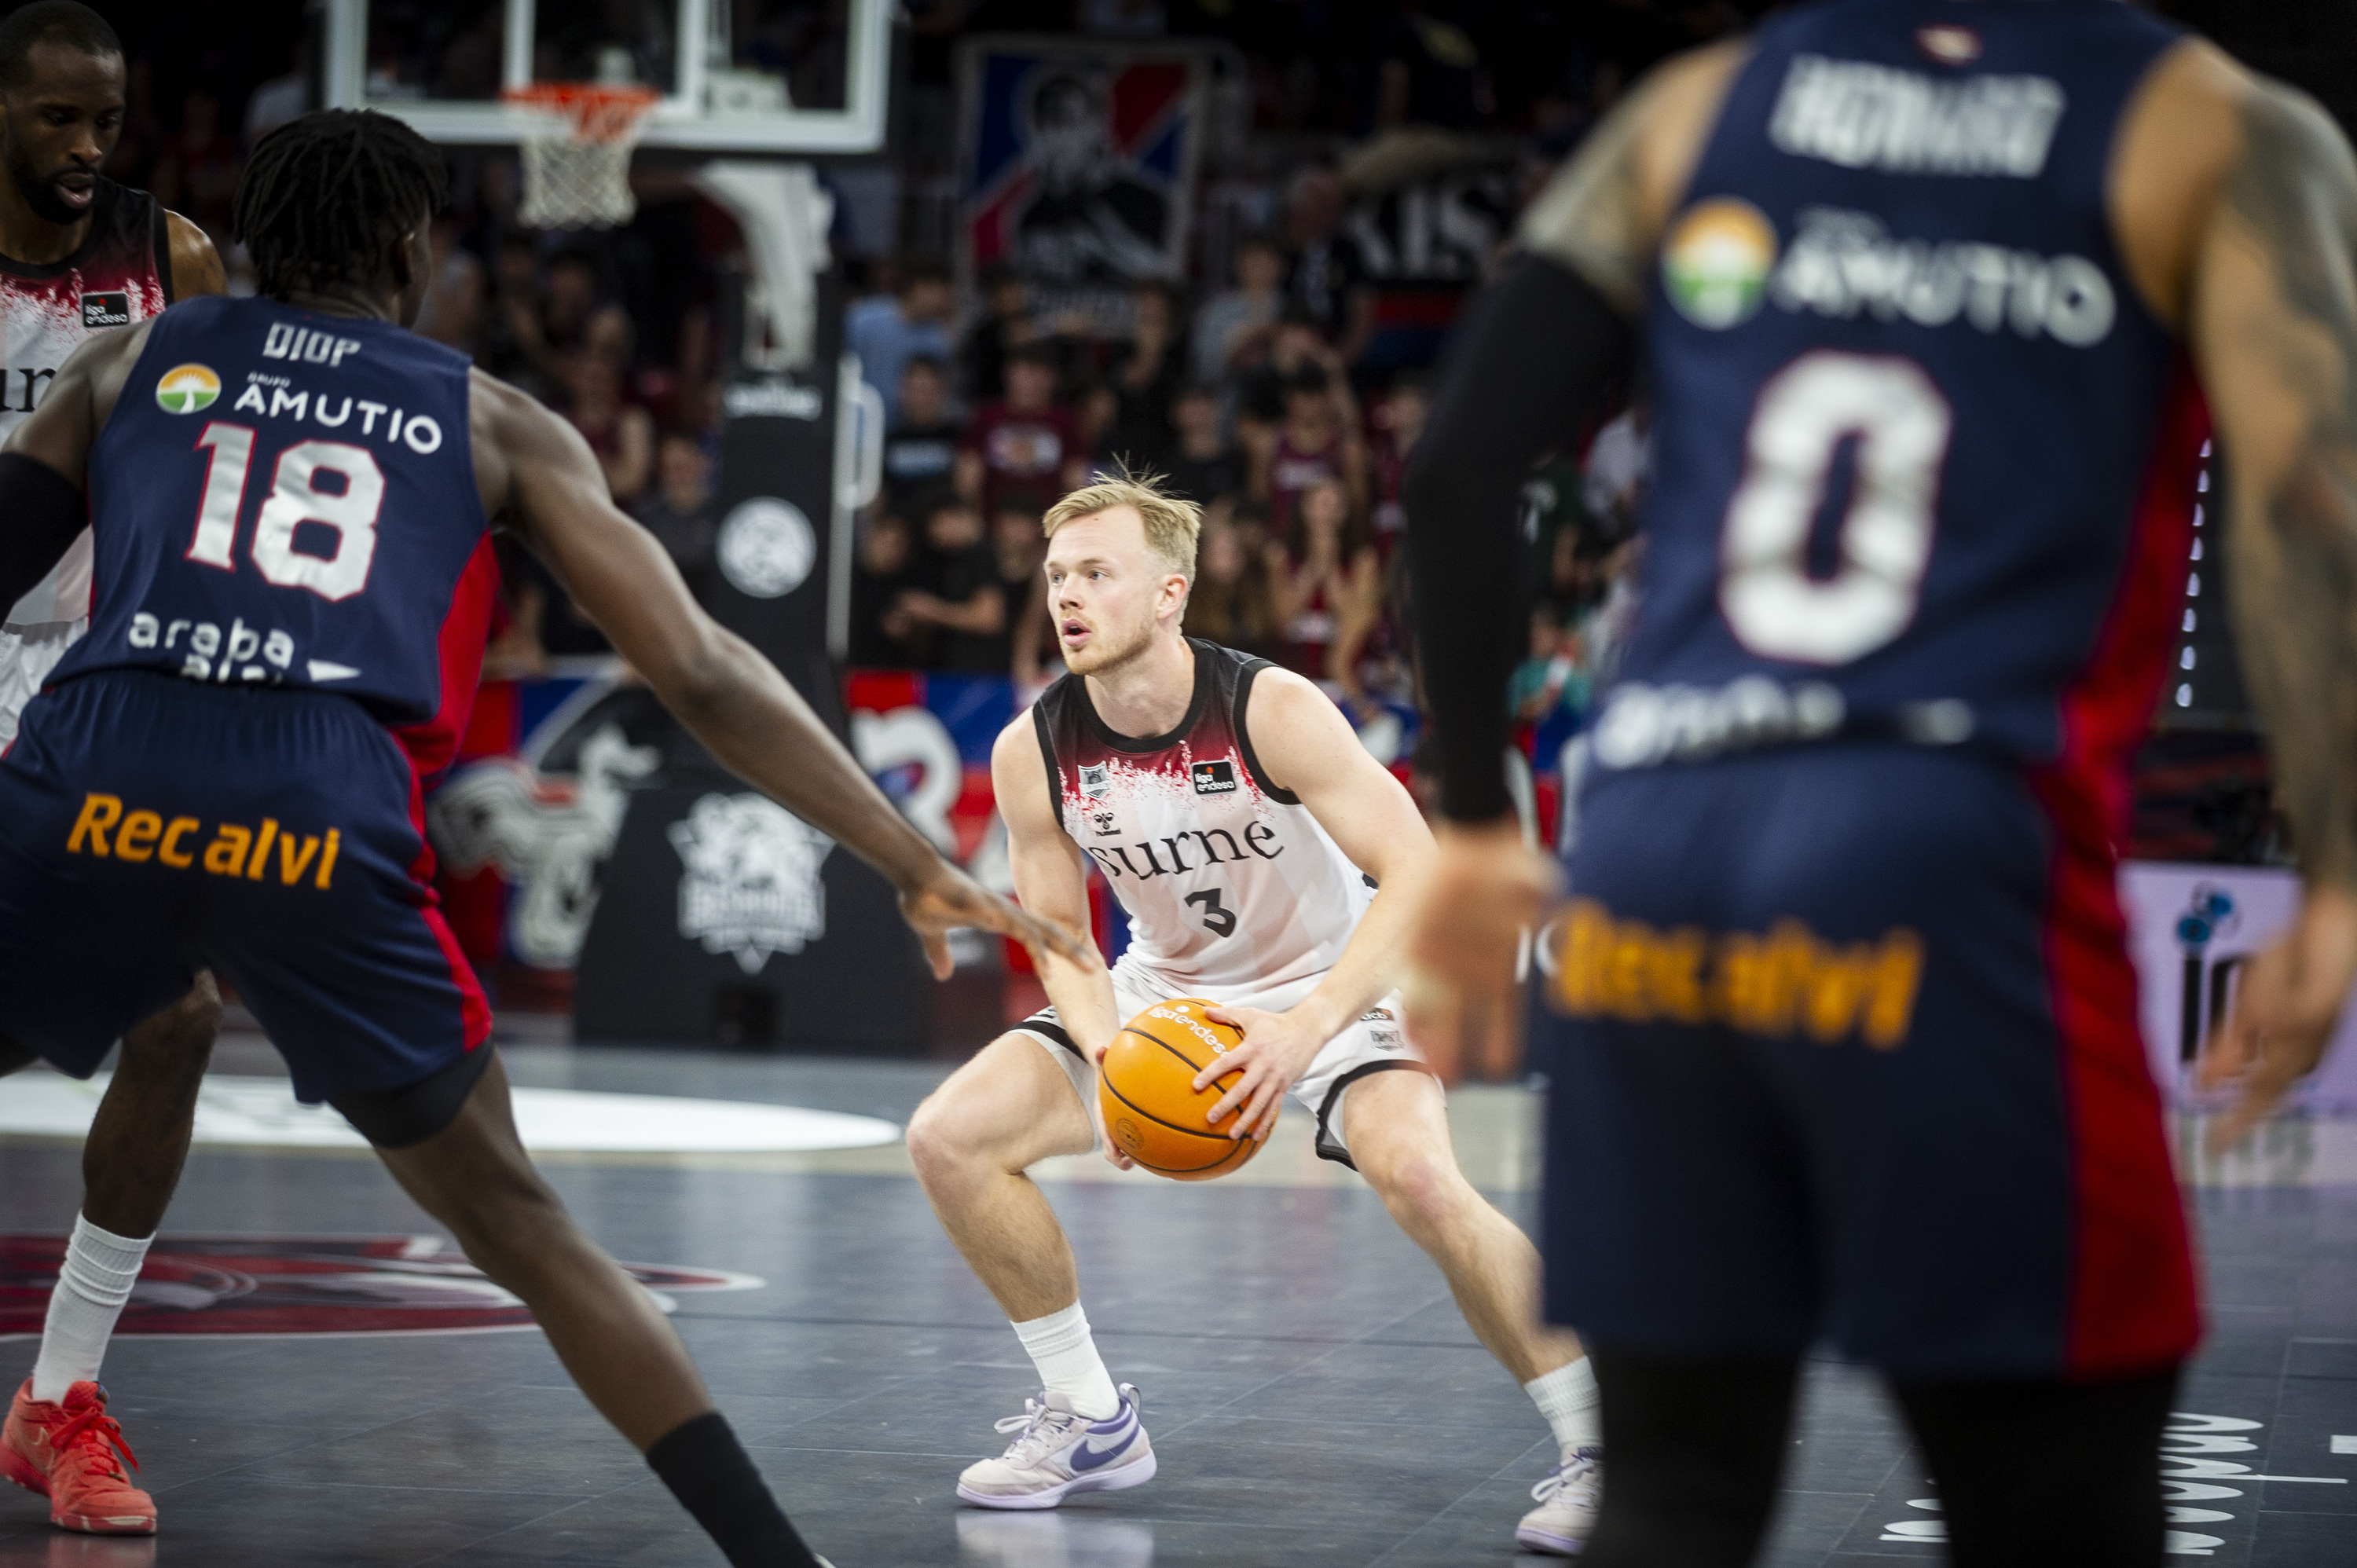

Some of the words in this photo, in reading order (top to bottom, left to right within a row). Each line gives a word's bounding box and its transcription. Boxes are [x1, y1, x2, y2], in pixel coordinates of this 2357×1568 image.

[262, 322, 361, 367] DIOP
[233, 383, 442, 454] AMUTIO
[184, 420, 386, 603] 18
[1717, 348, 1956, 666] 0
[129, 613, 295, 669] araba
[1194, 773, 1214, 784] liga
[1197, 781, 1235, 792] endesa
[66, 792, 341, 890] Recalvi
[1089, 819, 1285, 881] surne
[1185, 888, 1237, 938] 3
